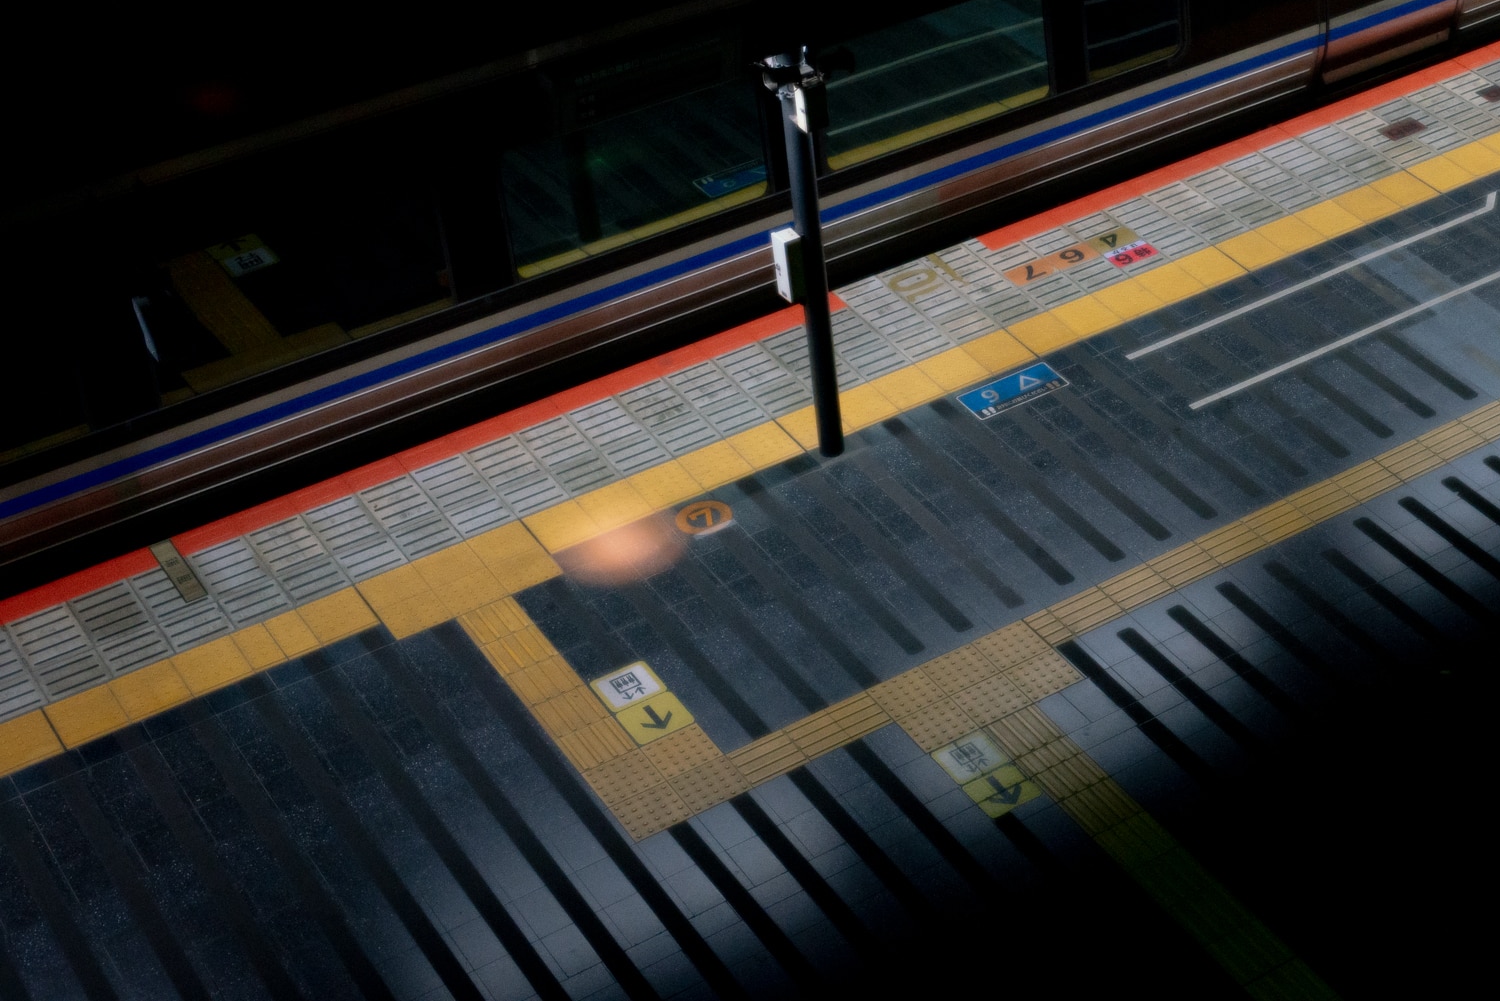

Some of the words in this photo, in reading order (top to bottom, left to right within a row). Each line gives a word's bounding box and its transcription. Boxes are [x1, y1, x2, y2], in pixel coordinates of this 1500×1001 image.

[1058, 249, 1085, 264] 6
[1024, 265, 1048, 281] 7
[980, 388, 1000, 404] 9
[686, 506, 715, 528] 7
